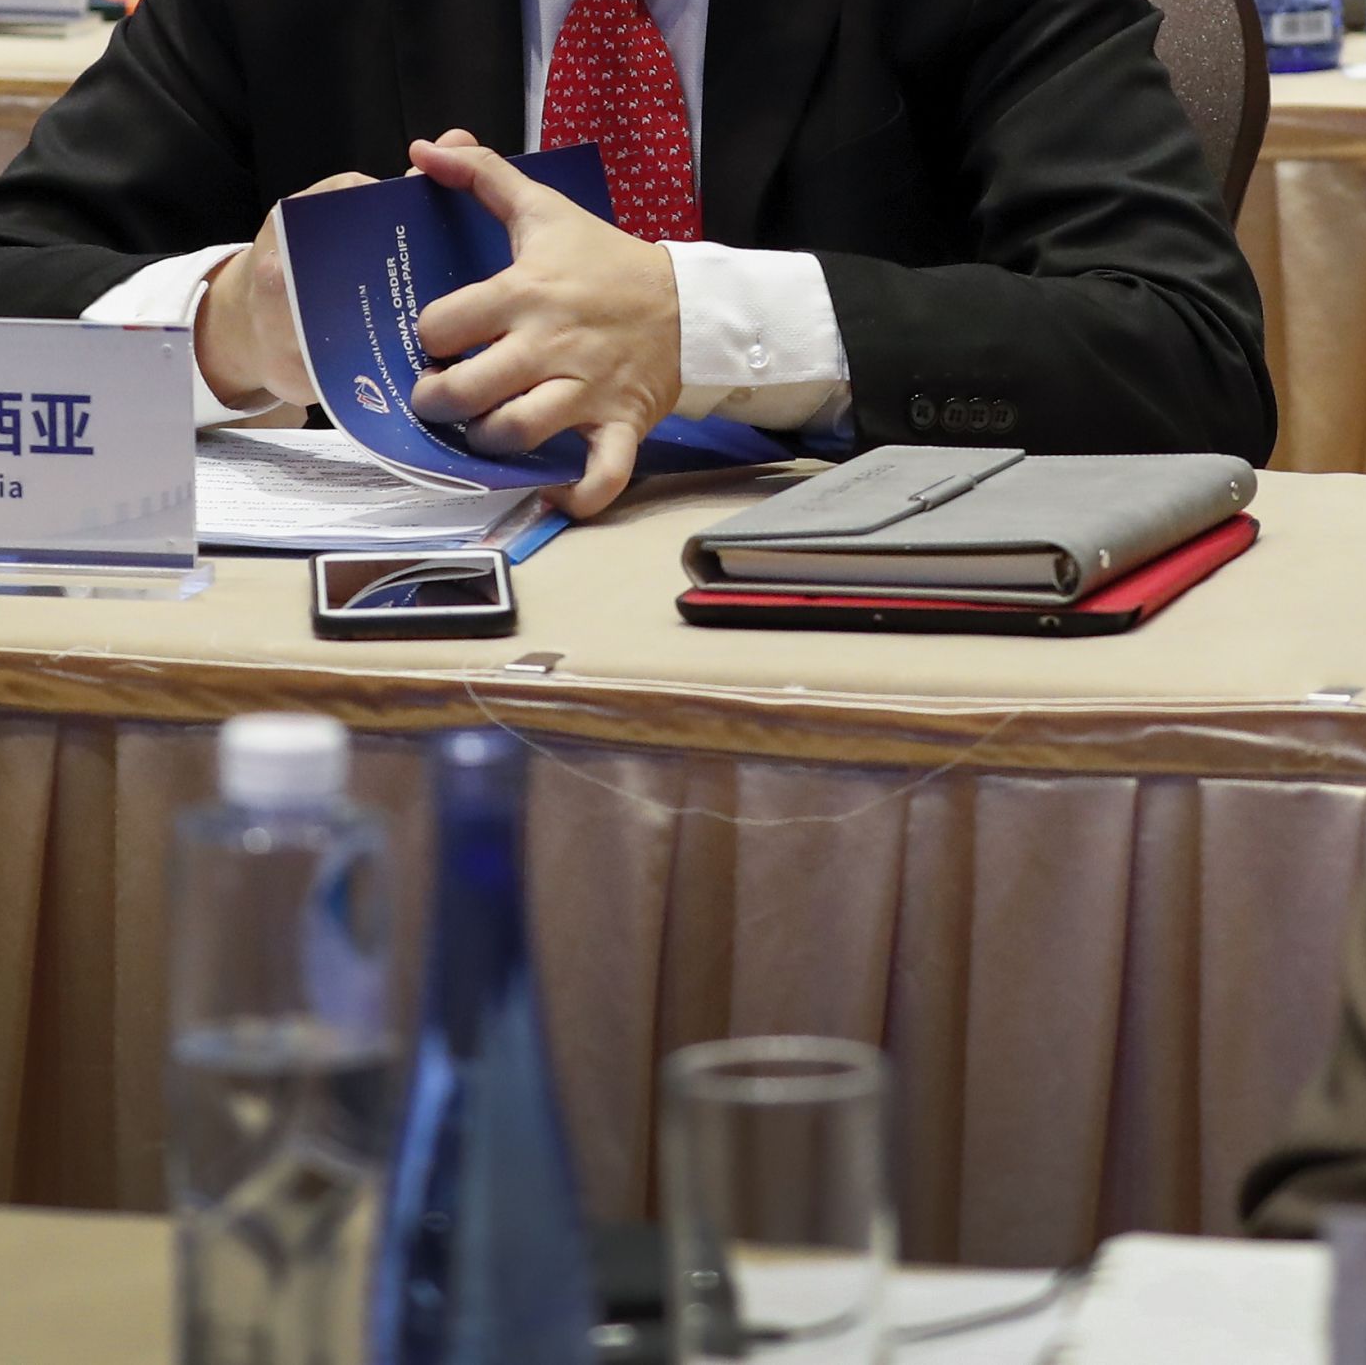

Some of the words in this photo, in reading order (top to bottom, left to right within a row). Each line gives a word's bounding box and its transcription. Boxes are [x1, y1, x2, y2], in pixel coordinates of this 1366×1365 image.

[386, 256, 403, 309] ORDER
[395, 224, 419, 319] ASIA-PACIFIC
[358, 284, 374, 328] FORUM
[396, 311, 423, 381] NATIONAL
